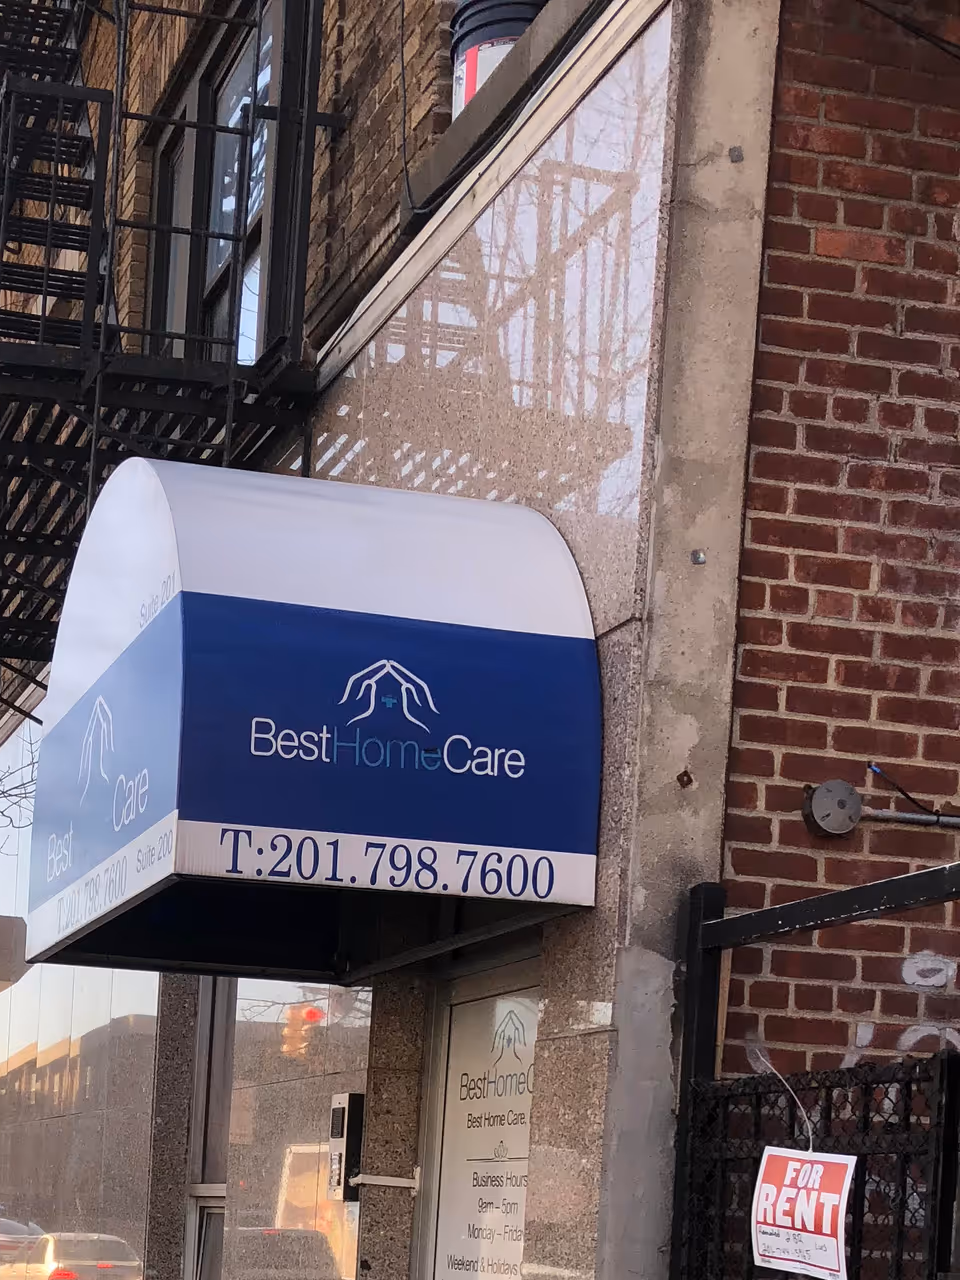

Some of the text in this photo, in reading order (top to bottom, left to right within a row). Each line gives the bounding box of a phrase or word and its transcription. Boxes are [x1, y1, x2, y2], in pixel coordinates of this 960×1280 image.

[139, 592, 159, 628] Suite
[136, 829, 173, 874] Suite 200
[220, 827, 555, 900] T:201.798.7600
[467, 1113, 482, 1129] Best
[484, 1112, 505, 1128] Home
[472, 1171, 528, 1188] Business Hours
[784, 1160, 824, 1189] FOR
[477, 1197, 494, 1214] 9am
[501, 1198, 518, 1215] 5pm
[757, 1183, 840, 1235] RENT
[468, 1223, 496, 1244] Monday
[447, 1254, 479, 1273] Weekend
[479, 1257, 486, 1273] &
[487, 1259, 518, 1279] Holidays
